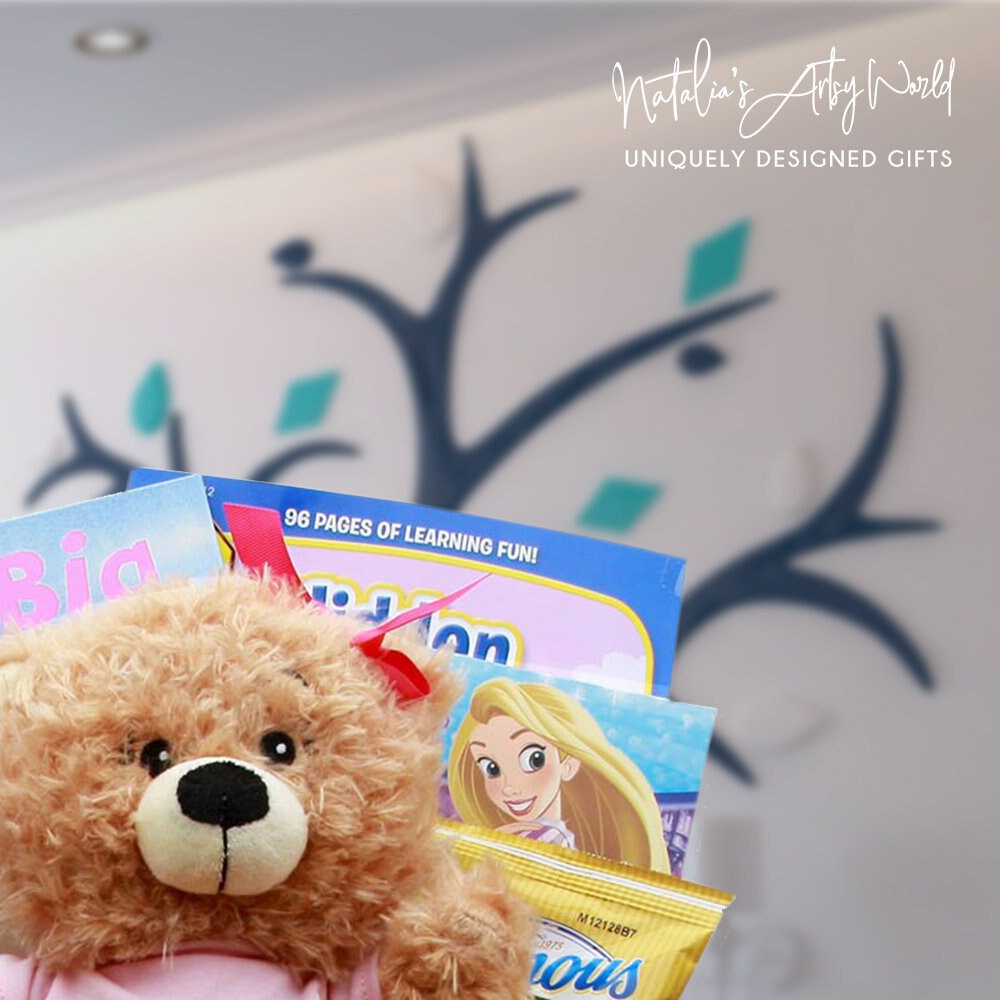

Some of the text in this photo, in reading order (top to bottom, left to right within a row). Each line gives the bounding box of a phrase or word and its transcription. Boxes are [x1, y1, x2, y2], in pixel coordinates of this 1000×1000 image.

[284, 508, 539, 564] 96 PAGES OF LEARNING FUN!
[529, 952, 643, 1000] ous
